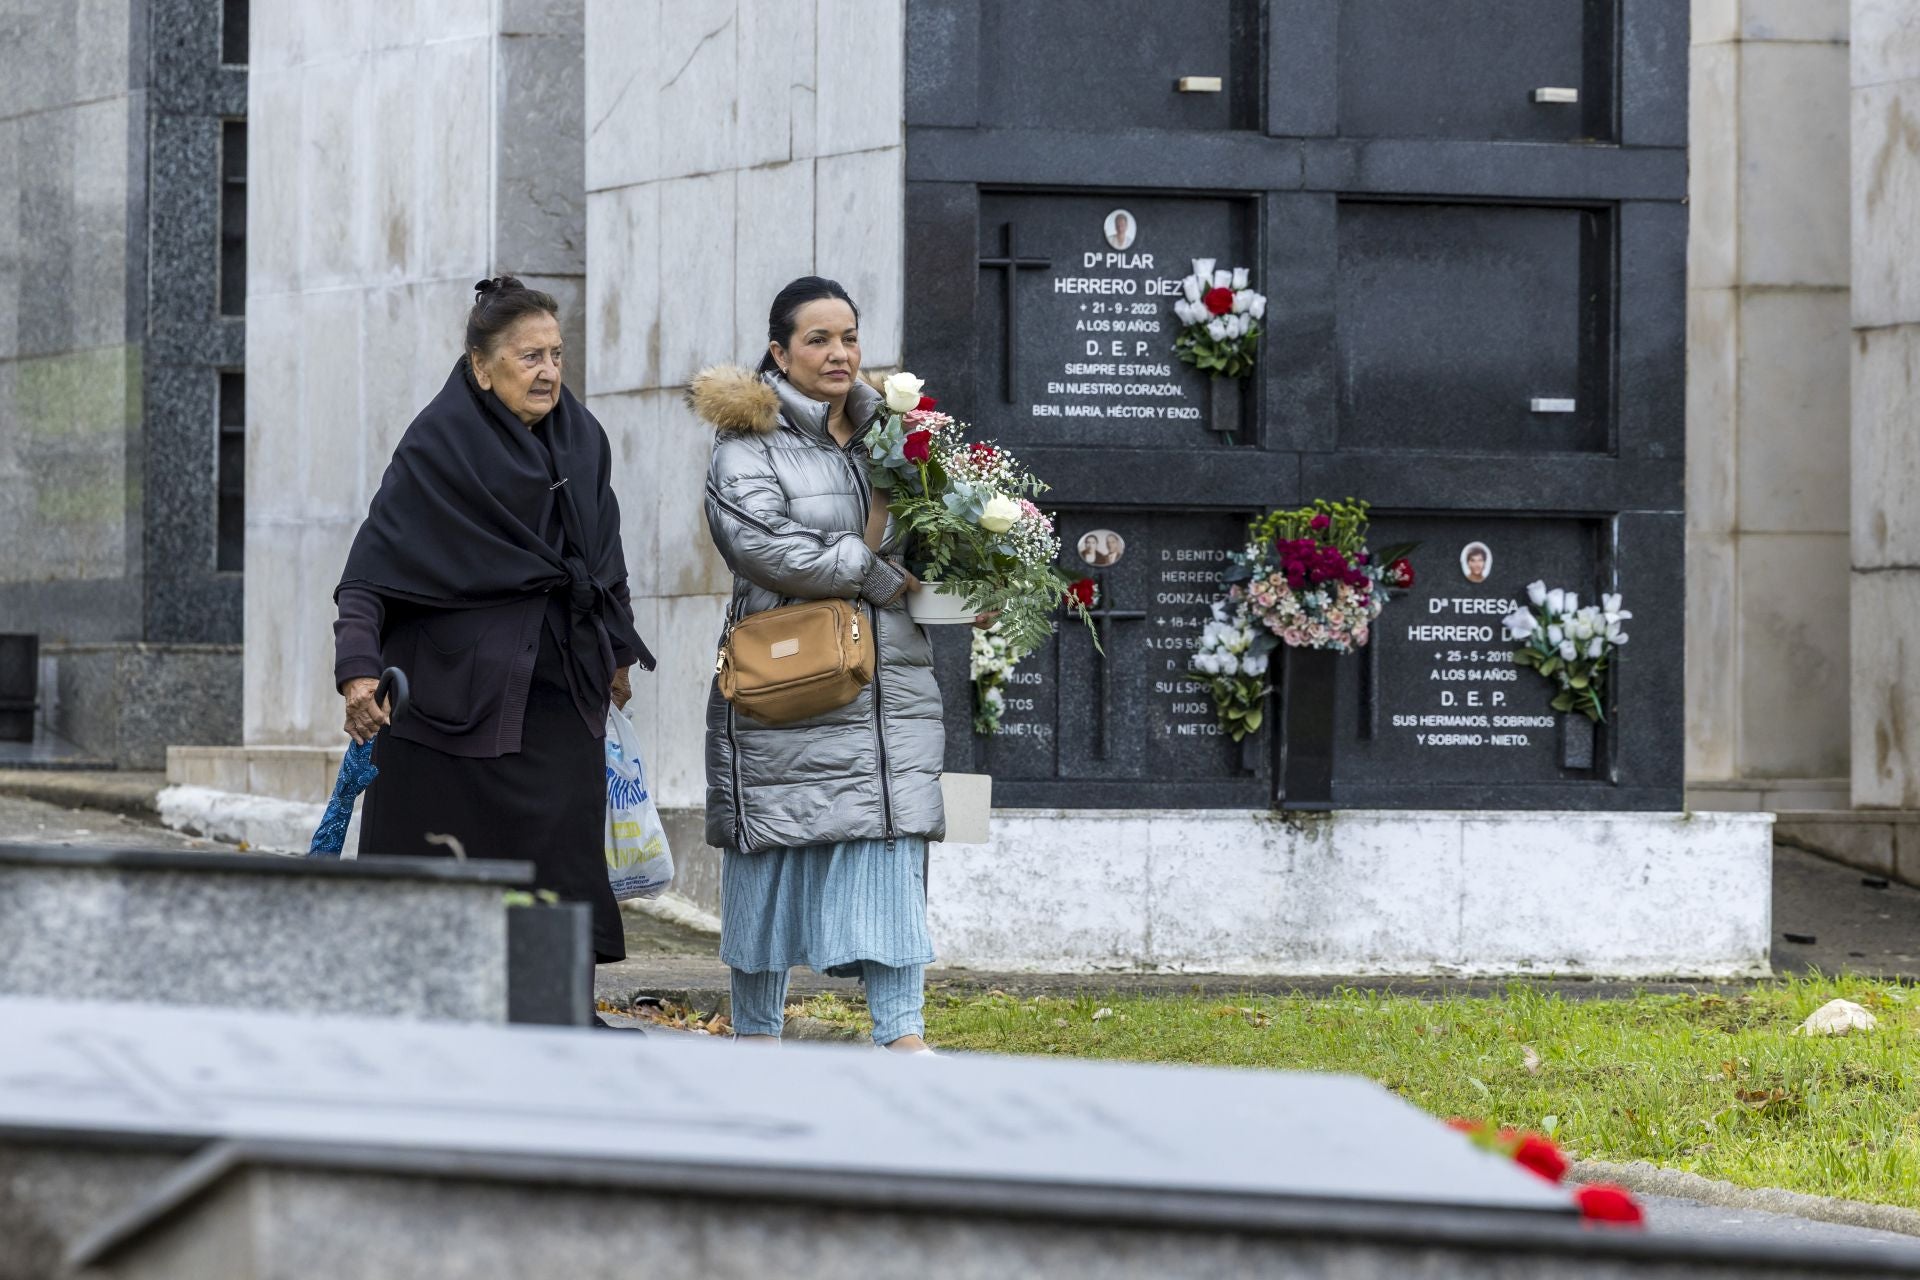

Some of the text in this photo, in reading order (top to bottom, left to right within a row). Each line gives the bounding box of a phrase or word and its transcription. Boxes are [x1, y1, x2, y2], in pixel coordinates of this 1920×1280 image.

[1106, 253, 1153, 269] PILAR
[1054, 276, 1182, 296] HERRERO DÍEZ
[1092, 303, 1105, 314] 21
[1115, 304, 1122, 315] 9
[1131, 304, 1157, 315] 2023
[1076, 319, 1160, 333] A LOS 90 AÑOS
[1086, 340, 1150, 356] D. E. P.
[1065, 362, 1171, 376] SIEMPRE ESTARÁS
[1048, 381, 1184, 396] EN NUESTRO CORAZÓN.
[1032, 404, 1062, 418] BENI,
[1107, 404, 1155, 418] HÉCTOR
[1157, 407, 1166, 418] Y
[1167, 407, 1202, 420] ENZO.
[1177, 550, 1225, 561] BENITO
[1162, 571, 1224, 582] HERRERO
[1452, 598, 1518, 614] TERESA
[1408, 626, 1493, 642] HERRERO
[1157, 638, 1183, 649] LOS
[1447, 651, 1462, 662] 25
[1470, 651, 1478, 662] 5
[1430, 668, 1517, 681] A LOS 94 AÑOS
[1155, 682, 1211, 693] SU ESPO
[1441, 690, 1506, 706] D. E. P.
[1172, 703, 1208, 713] HIJOS
[1393, 715, 1555, 728] SUS HERMANOS, SOBRINOS
[1165, 724, 1224, 735] Y NIETOS
[1417, 735, 1425, 745] Y
[1427, 734, 1482, 746] SOBRINO
[1491, 735, 1531, 747] NIETO.
